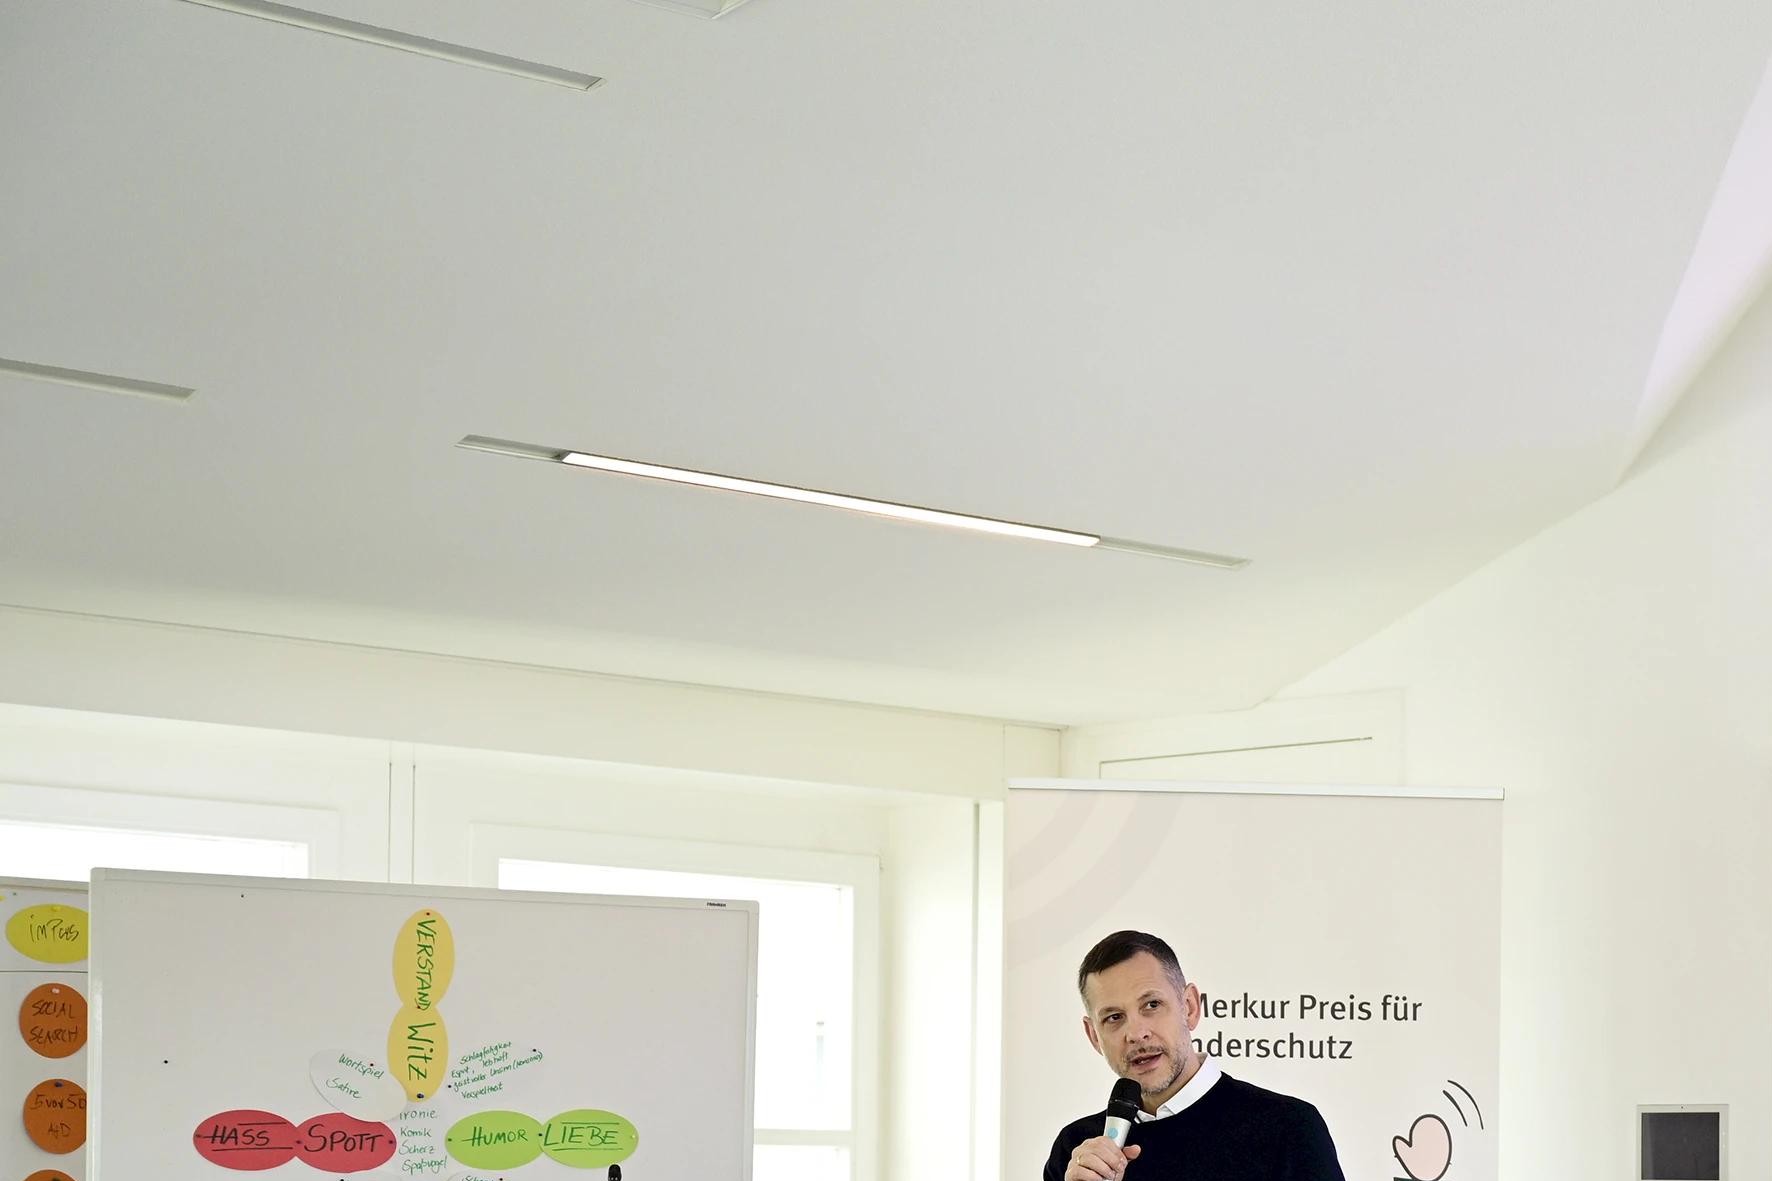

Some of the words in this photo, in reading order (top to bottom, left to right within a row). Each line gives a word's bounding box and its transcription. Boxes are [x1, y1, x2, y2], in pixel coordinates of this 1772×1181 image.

[414, 919, 437, 1011] VERSTAND
[31, 999, 76, 1019] SOCIAL
[1300, 994, 1372, 1021] Preis
[1381, 995, 1422, 1021] für
[29, 1025, 79, 1045] SEARCH
[325, 1077, 362, 1099] Satire
[203, 1124, 270, 1147] HASS
[400, 1126, 432, 1138] Komik
[462, 1125, 529, 1147] HUMOR
[543, 1123, 620, 1147] LIEBE
[398, 1139, 436, 1155] Scherz
